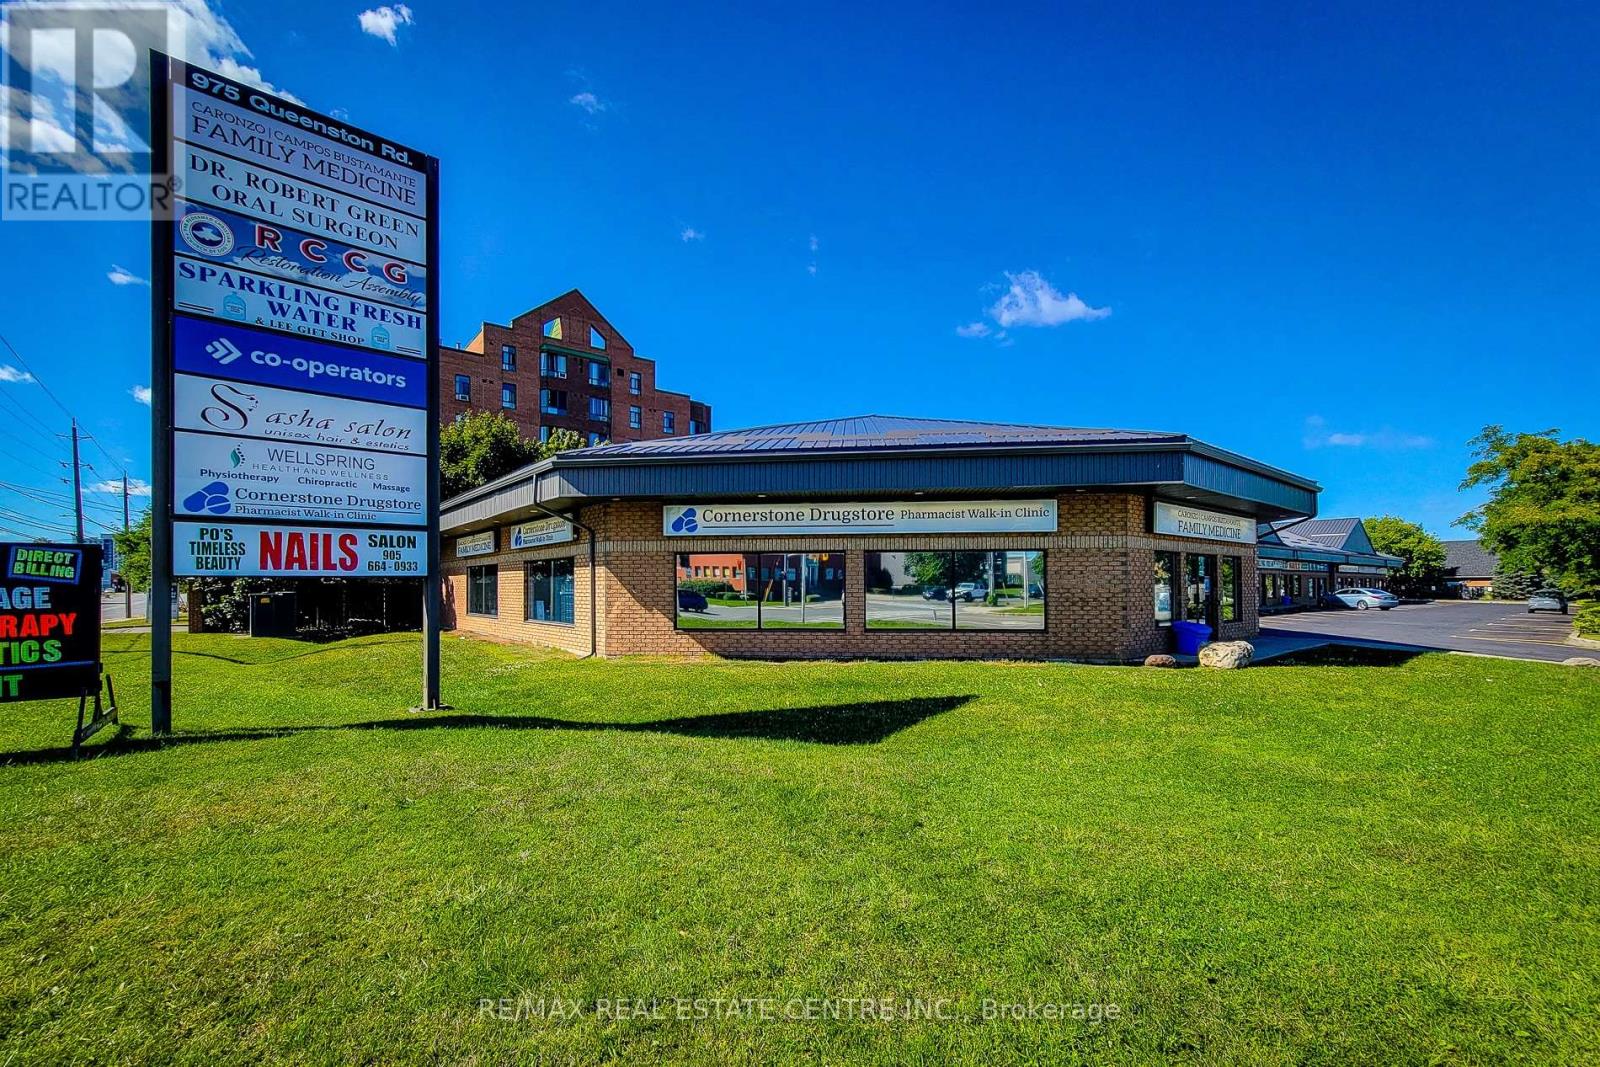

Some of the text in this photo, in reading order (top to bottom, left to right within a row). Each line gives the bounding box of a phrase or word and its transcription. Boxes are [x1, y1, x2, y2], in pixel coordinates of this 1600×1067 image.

[192, 73, 413, 166] 975 Queenston Rd.
[192, 102, 265, 134] CARONZO
[274, 130, 331, 157] CAMPOS
[334, 150, 416, 187] BUSTAMANTE
[192, 115, 416, 205] FAMILY MEDICINE
[191, 154, 418, 237] DR. ROBERT GREEN
[212, 185, 398, 250] ORAL SURGEON
[239, 246, 421, 307] Restoration Assembly
[178, 262, 421, 330] SPARKLING FRESH
[267, 301, 358, 332] WATER
[255, 316, 265, 326] &
[270, 319, 293, 331] LEE
[298, 325, 327, 338] GIFT
[331, 331, 365, 345] SHOP
[250, 350, 407, 388] co-operators
[264, 428, 310, 439] unisex
[317, 433, 344, 443] hair
[350, 437, 360, 445] &
[343, 419, 412, 440] salon
[267, 448, 375, 471] WELLSPRING
[200, 468, 411, 494] Physiotherapy Chiropractic Massage
[252, 463, 389, 481] HEALTH AND WELLNESS
[235, 487, 422, 510] Cornerstone Drugstore
[234, 505, 377, 520] Pharmacist Walk-in Clinic
[702, 507, 1050, 524] Cornerstone Drugstore Pharmacist Walk-in Clinic
[200, 527, 233, 541] PO'S
[368, 533, 417, 549] SALON
[1178, 520, 1241, 540] FAMILY MEDICINE
[16, 548, 75, 565] DIRECT
[189, 541, 246, 556] TIMELESS
[259, 531, 359, 572] NAILS
[382, 550, 401, 561] 905
[13, 561, 75, 579] BILLING
[195, 556, 241, 570] BEAUTY
